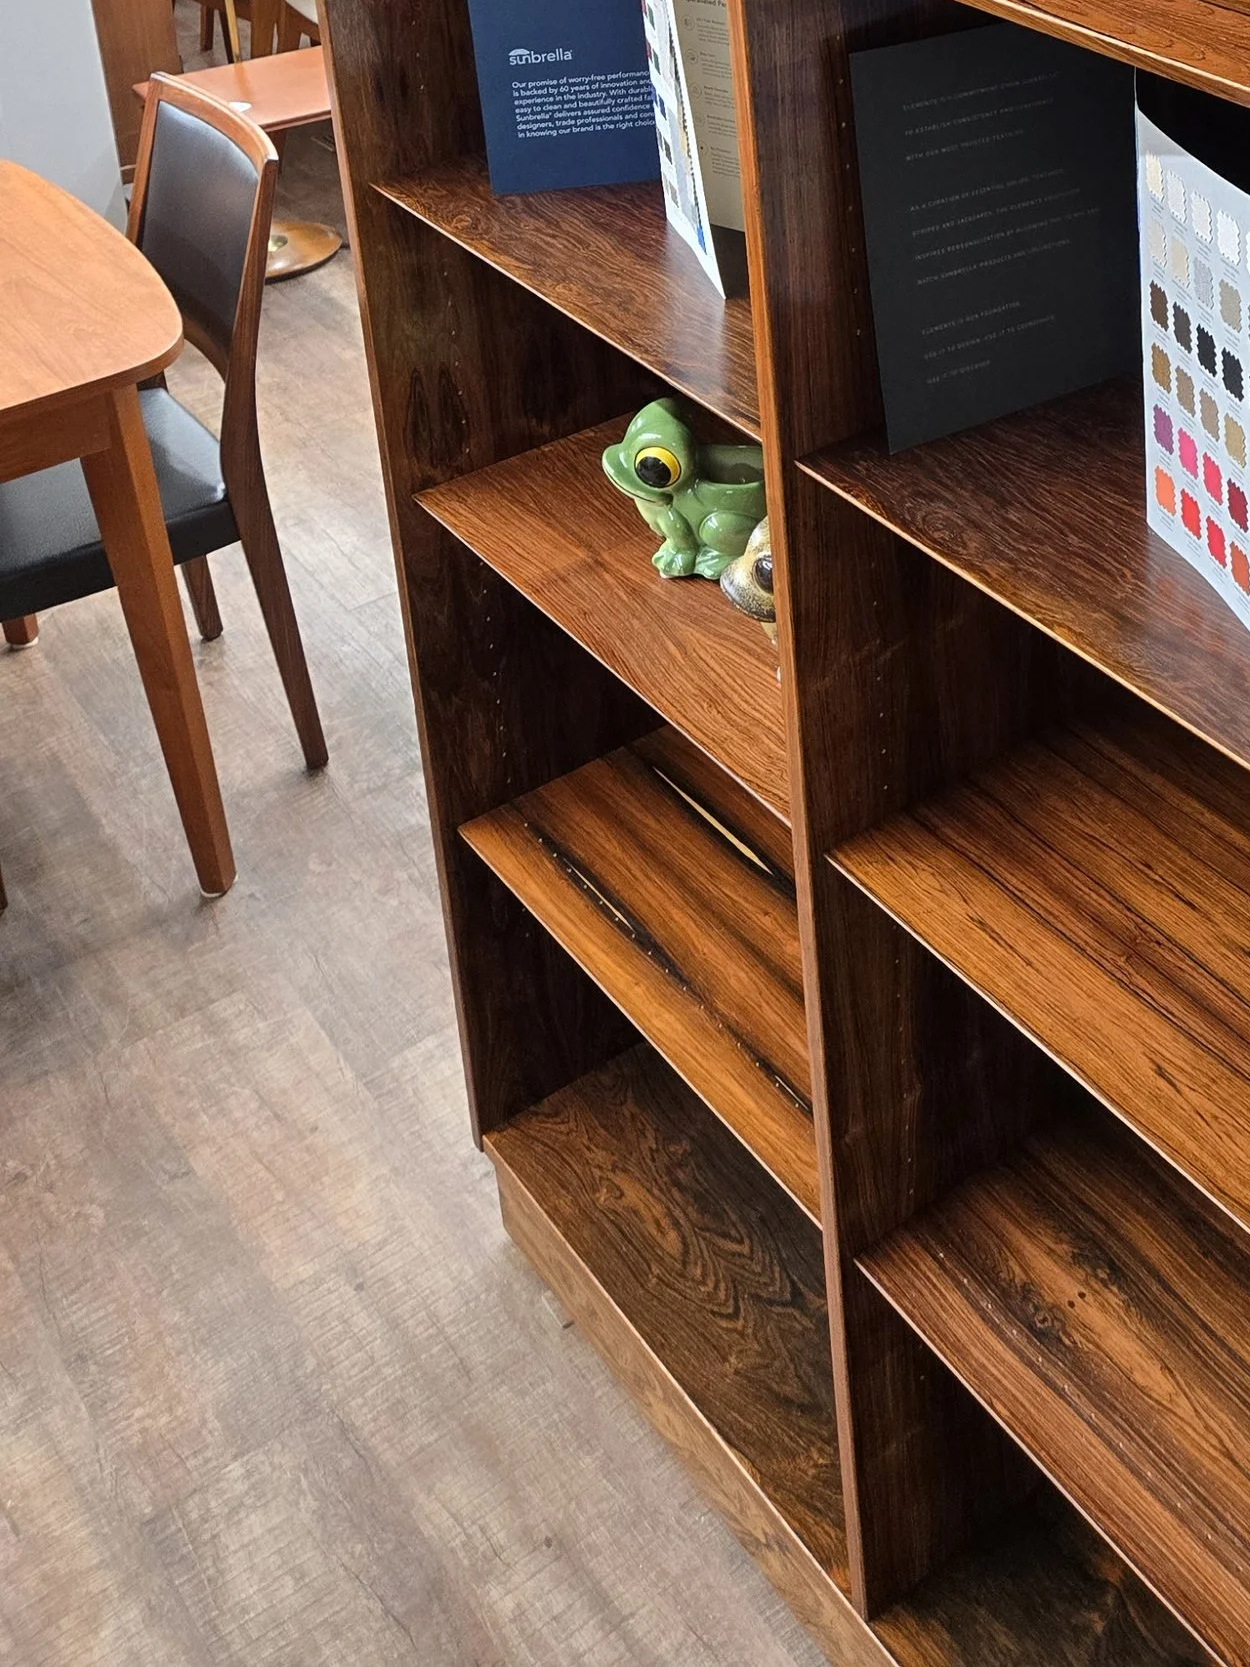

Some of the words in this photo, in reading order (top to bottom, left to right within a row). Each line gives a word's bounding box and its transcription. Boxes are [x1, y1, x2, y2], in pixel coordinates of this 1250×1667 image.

[509, 48, 572, 65] sunbrella
[512, 81, 527, 89] Our
[528, 79, 558, 89] promise
[559, 76, 567, 85] of
[568, 74, 606, 84] worry-free
[607, 71, 650, 81] performanc
[520, 87, 547, 96] backed
[549, 86, 558, 95] by
[560, 85, 569, 93] 60
[570, 84, 590, 93] years
[591, 82, 599, 90] of
[600, 79, 638, 88] innovation
[514, 96, 554, 106] experience
[563, 93, 576, 101] the
[609, 88, 627, 96] With
[563, 101, 577, 109] and
[578, 96, 616, 106] beautifully
[617, 94, 643, 103] crafted
[554, 110, 581, 118] delivers
[583, 106, 611, 115] assured
[611, 103, 651, 112] confidence
[526, 129, 558, 137] knowing
[572, 124, 594, 132] brand
[616, 120, 633, 130] right
[576, 114, 623, 126] professionals
